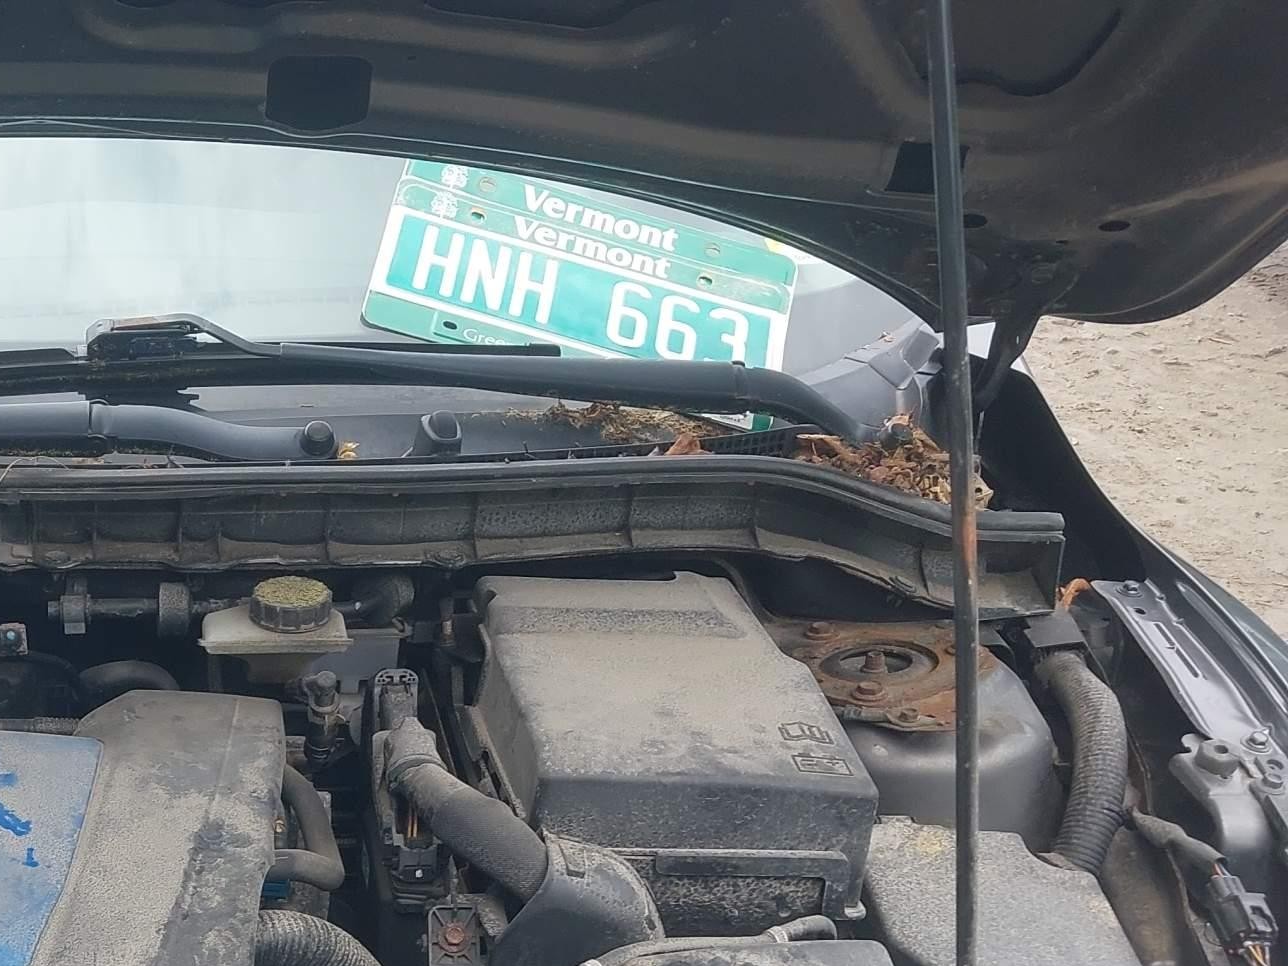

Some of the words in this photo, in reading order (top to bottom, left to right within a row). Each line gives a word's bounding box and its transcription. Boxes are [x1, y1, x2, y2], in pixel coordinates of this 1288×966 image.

[514, 215, 672, 278] Vermont
[524, 184, 679, 251] Vermont
[412, 225, 559, 324] HNH
[607, 280, 749, 362] 663
